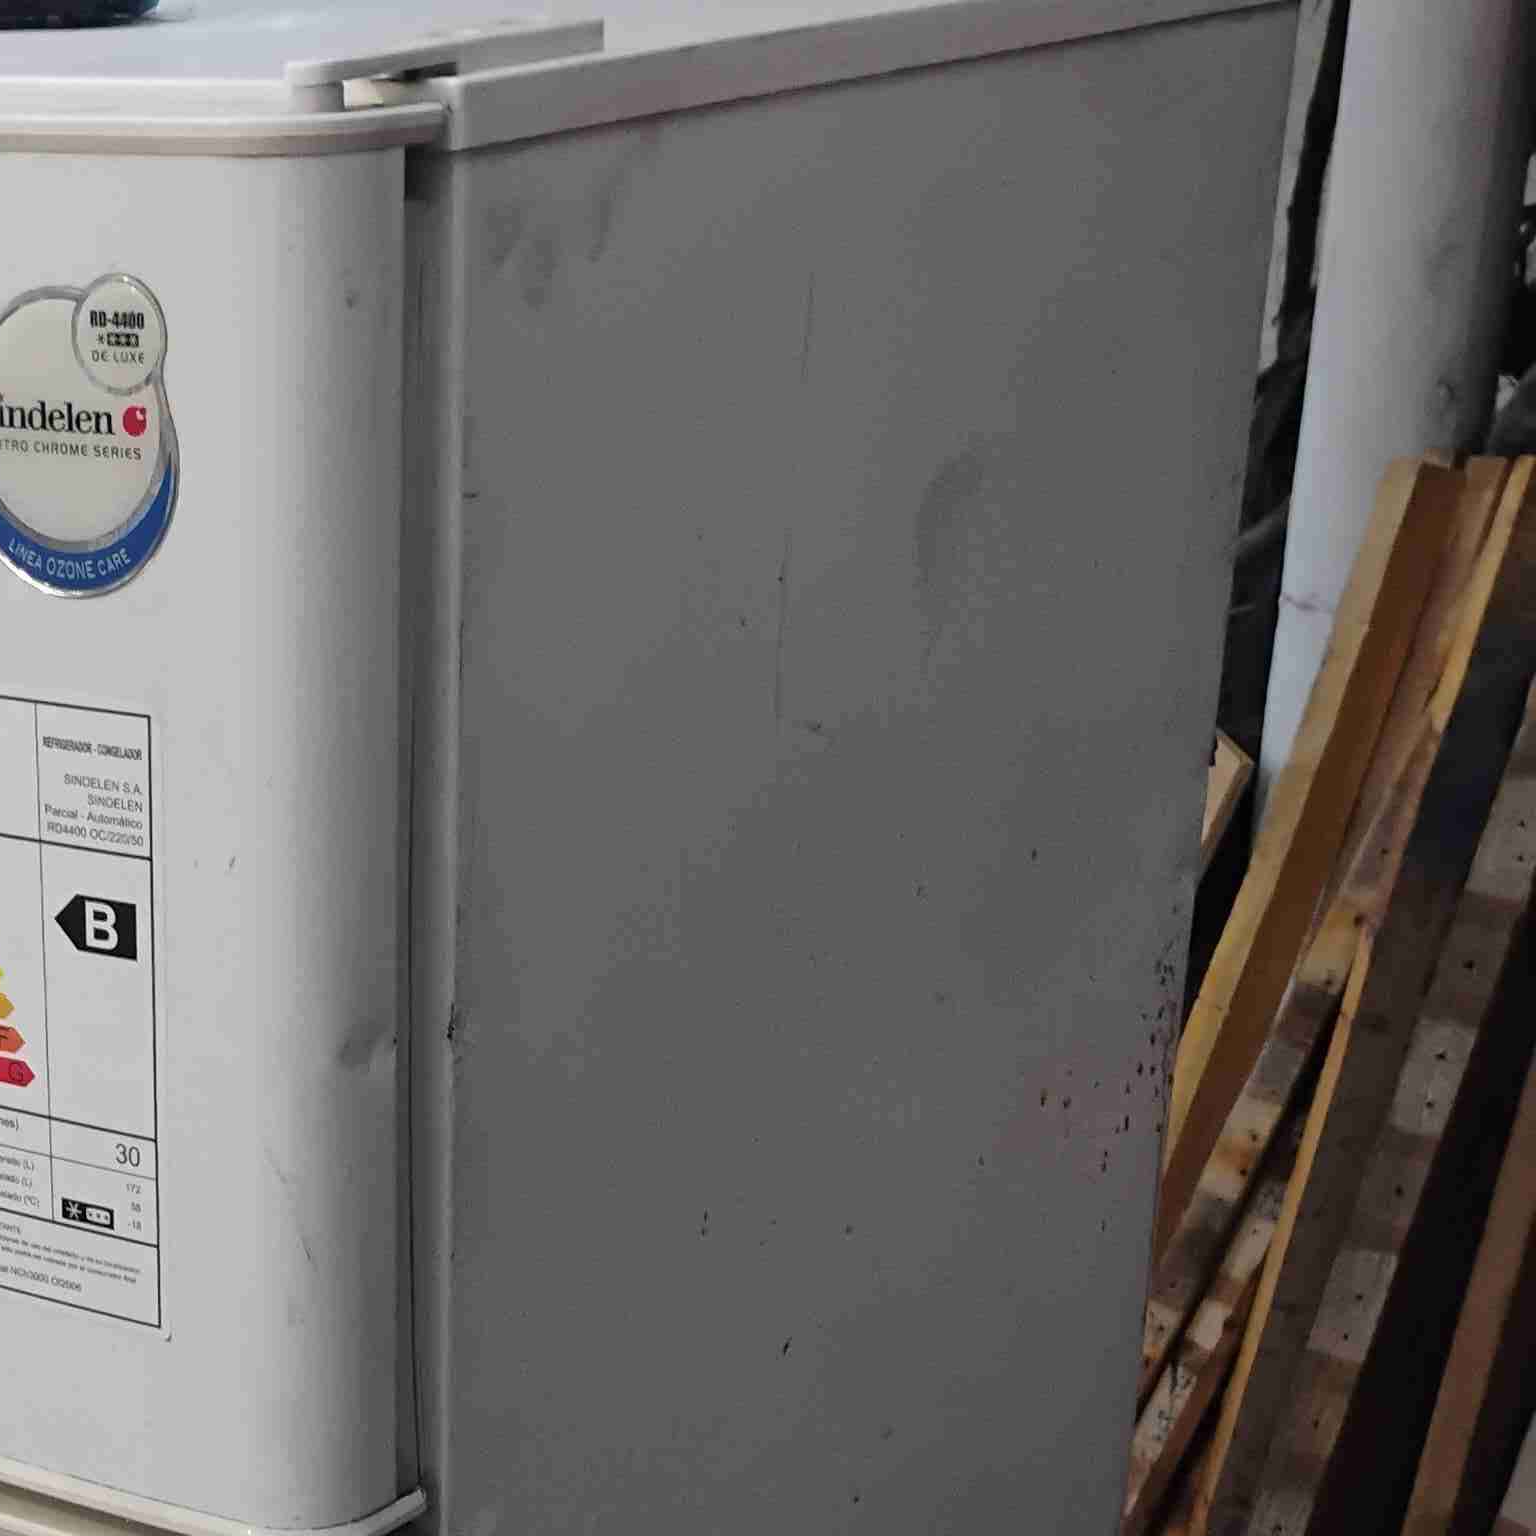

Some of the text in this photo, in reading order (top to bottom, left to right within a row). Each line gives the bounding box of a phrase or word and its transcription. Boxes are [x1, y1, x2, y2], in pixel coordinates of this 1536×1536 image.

[90, 310, 144, 329] RD-4400
[91, 350, 144, 364] DE LUXE
[33, 441, 88, 457] CHROME
[94, 446, 142, 461] SERIES
[46, 556, 96, 579] OZONE
[97, 548, 131, 575] CARE
[64, 774, 119, 793] SINDELEN
[44, 803, 79, 819] Parcial
[88, 794, 143, 813] SINDELEN
[84, 900, 119, 951] B
[8, 1061, 24, 1083] G
[115, 1143, 141, 1167] 30
